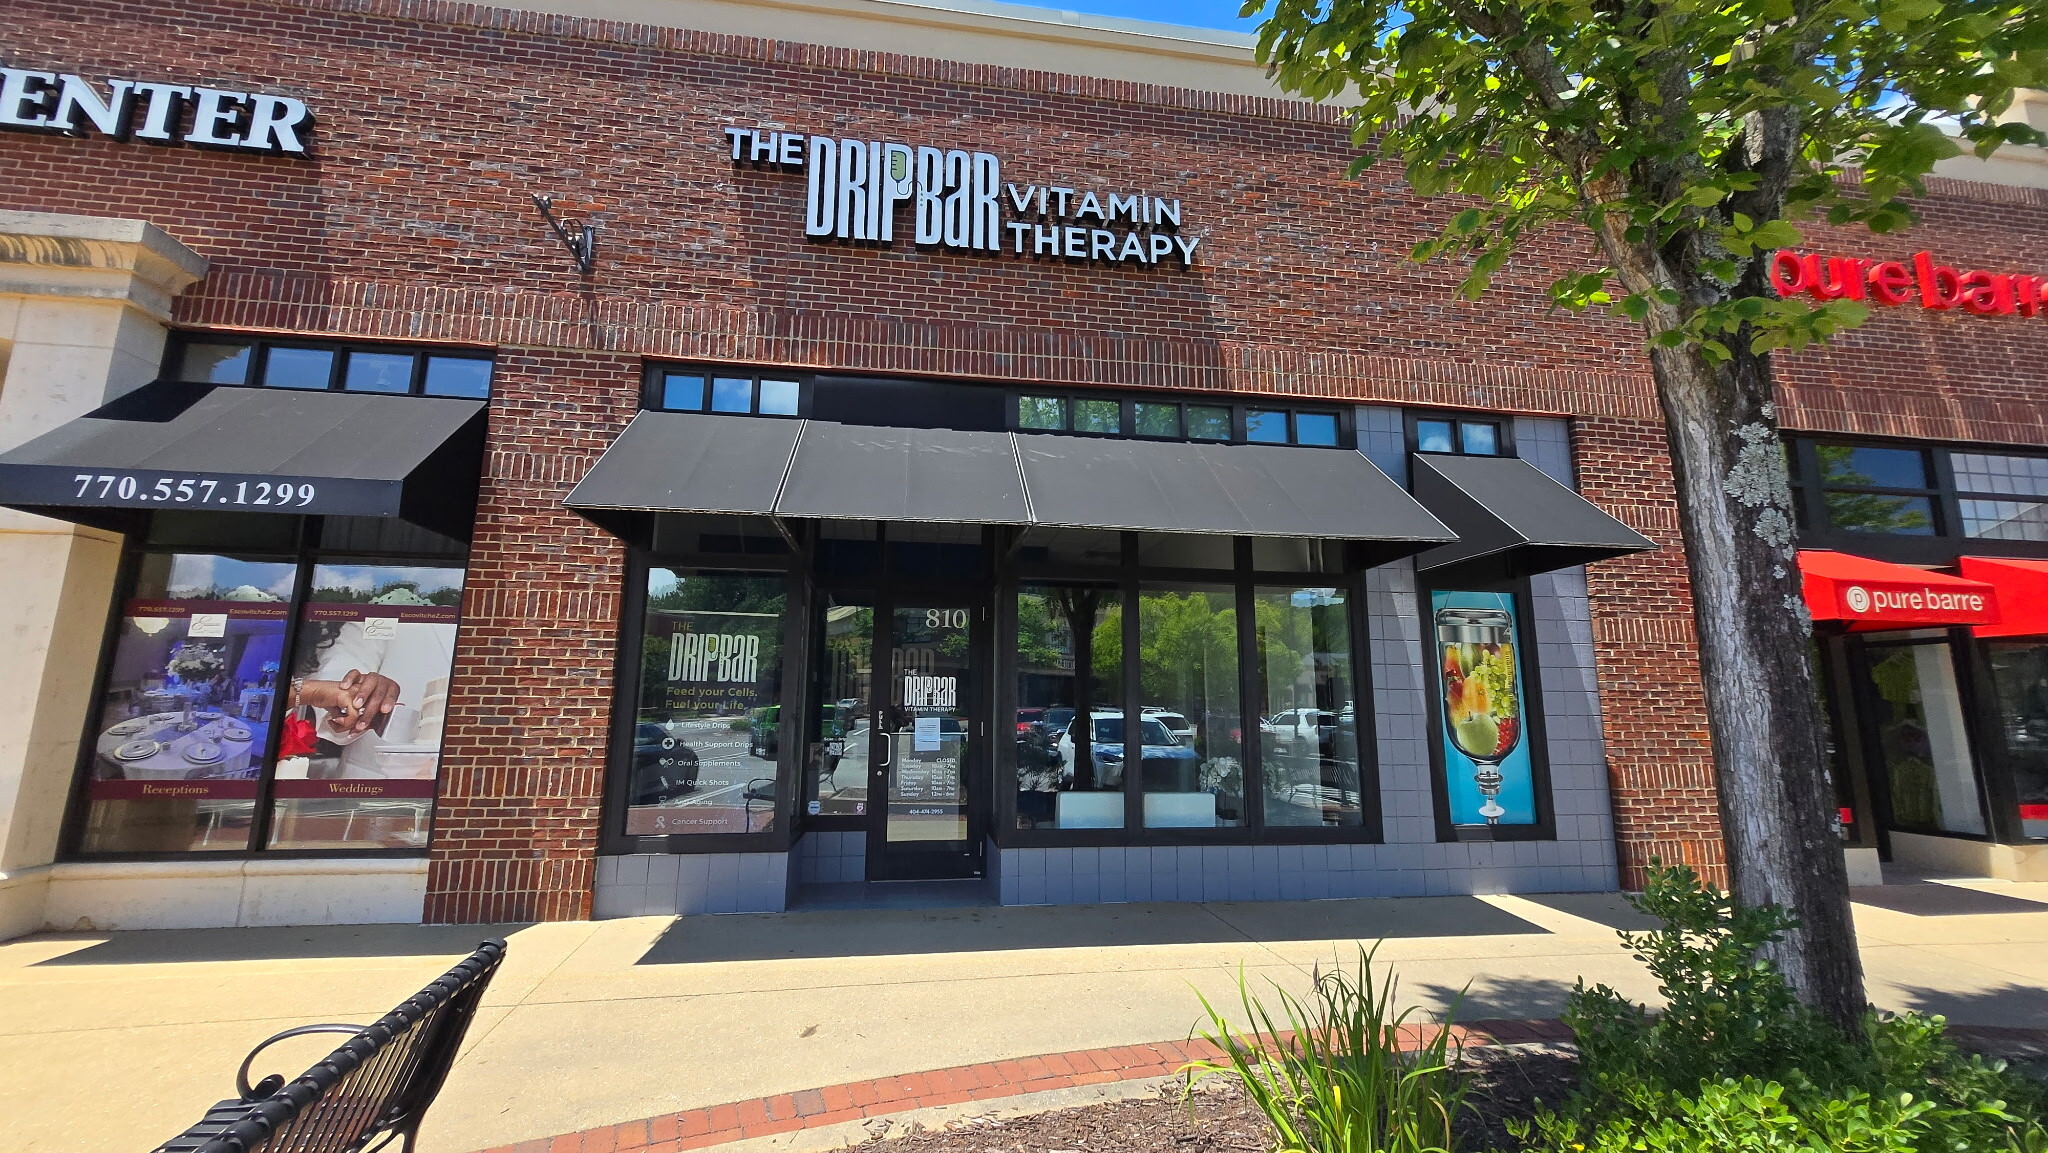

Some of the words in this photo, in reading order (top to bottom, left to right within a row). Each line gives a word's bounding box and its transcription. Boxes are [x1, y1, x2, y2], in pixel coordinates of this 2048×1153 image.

[0, 67, 307, 155] ENTER
[724, 127, 804, 165] THE
[1008, 182, 1181, 226] VITAMIN
[1006, 221, 1200, 265] THERAPY
[1912, 250, 2048, 318] barr
[74, 474, 315, 507] 770.557.1299
[1872, 591, 1923, 612] pure
[1924, 587, 1983, 611] barre
[925, 608, 967, 629] 810
[671, 621, 695, 631] THE
[903, 668, 918, 676] THE
[666, 686, 696, 696] Feed
[699, 688, 725, 698] your
[728, 687, 758, 697] Cells.
[665, 699, 690, 709] Fuel
[693, 701, 720, 710] your
[681, 721, 711, 730] Lifestyle
[712, 721, 731, 730] Drips
[679, 740, 702, 748] Health
[704, 740, 733, 749] Support
[734, 740, 754, 749] Drips
[695, 760, 741, 768] Supplements
[142, 783, 209, 796] Receptions
[329, 782, 384, 795] Weddings
[698, 818, 728, 826] Support
